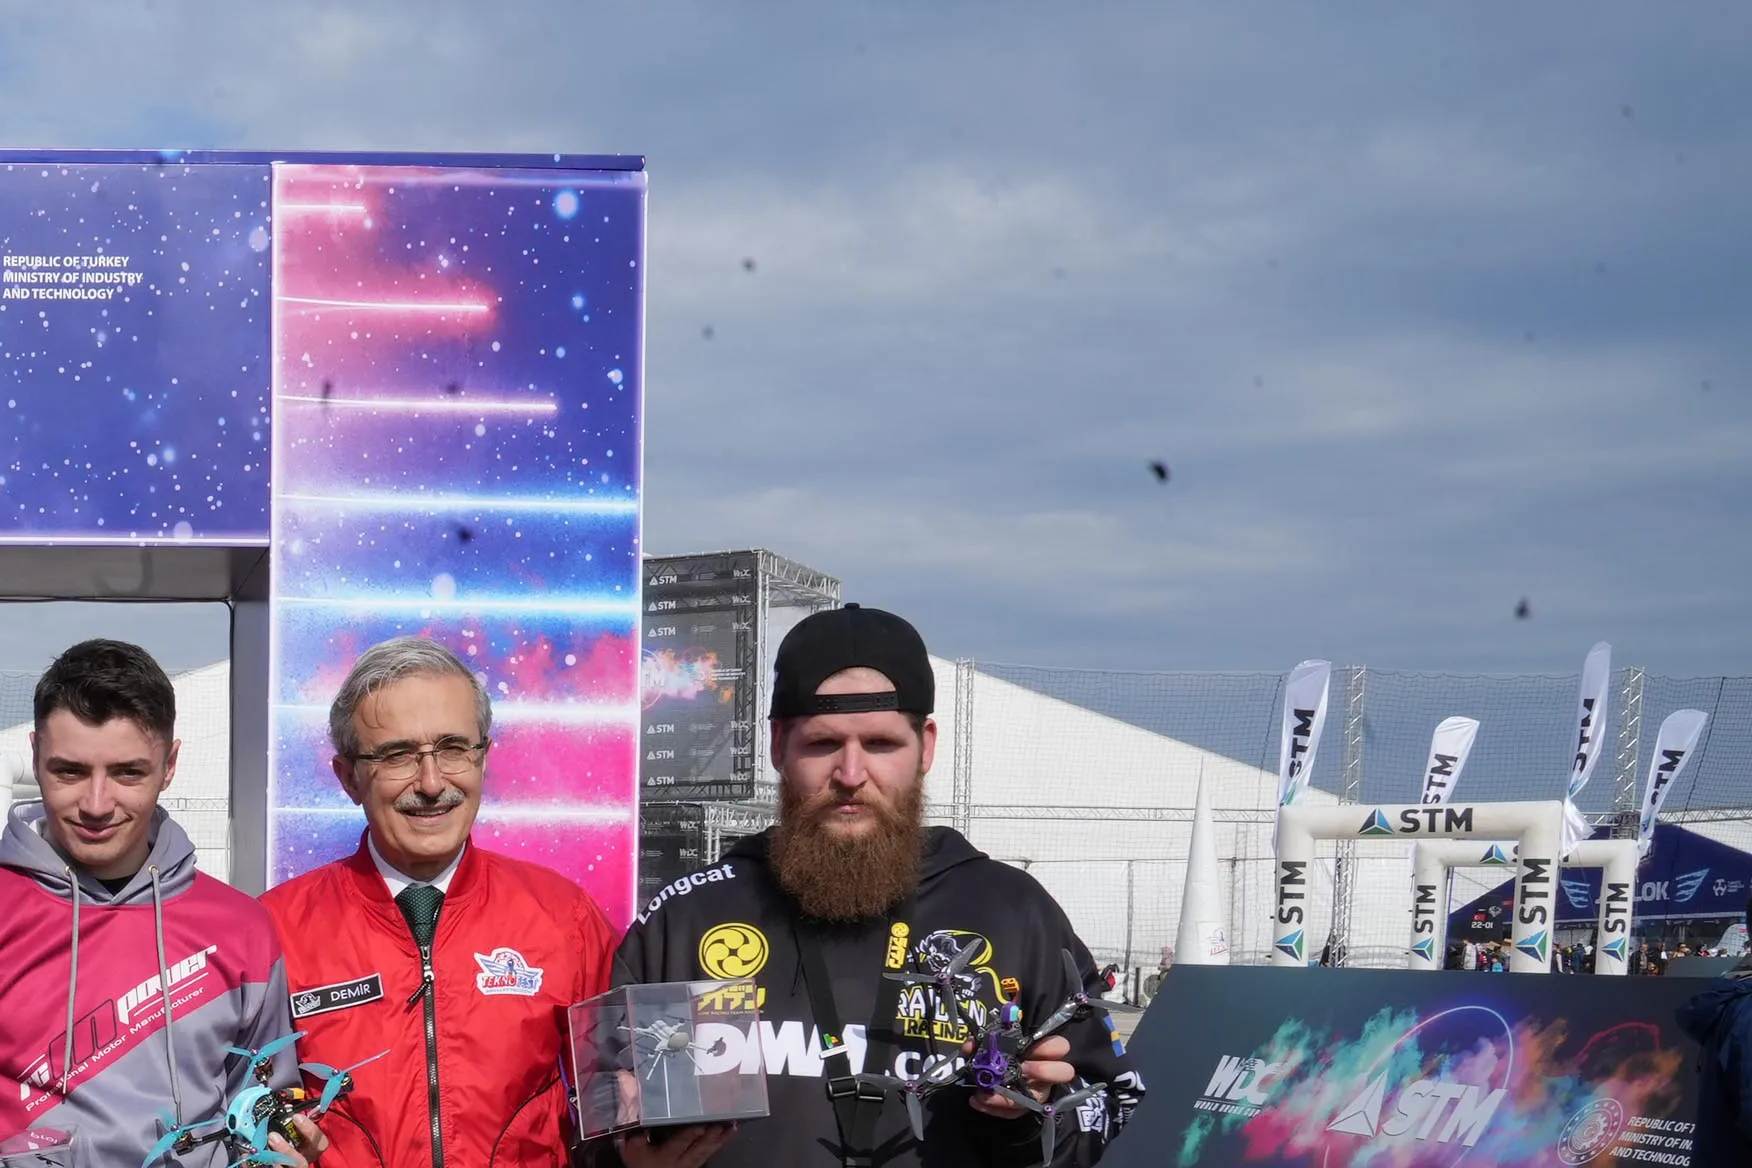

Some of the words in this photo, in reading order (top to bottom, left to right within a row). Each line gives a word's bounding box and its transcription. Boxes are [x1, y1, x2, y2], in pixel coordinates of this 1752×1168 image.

[3, 255, 61, 268] REPUBLIC
[63, 255, 81, 268] OF
[82, 255, 130, 268] TURKEY
[3, 271, 62, 284] MINISTRY
[63, 271, 80, 284] OF
[82, 271, 144, 284] INDUSTRY
[3, 288, 30, 300] AND
[31, 288, 115, 300] TECHNOLOGY
[656, 724, 675, 734] STM
[656, 750, 675, 760] STM
[1288, 708, 1315, 779] STM
[656, 776, 675, 786] STM
[1422, 753, 1458, 804] STM
[1399, 807, 1474, 833] STM
[637, 863, 736, 926] Longcat
[1278, 861, 1307, 925] STM
[1519, 858, 1551, 925] STM
[1414, 885, 1437, 934] STM
[1604, 883, 1630, 933] STM
[331, 983, 371, 1002] DEMİR
[92, 1034, 128, 1063] Motor
[1204, 1055, 1289, 1105] WDC
[1382, 1079, 1508, 1149] STM
[1627, 1116, 1676, 1132] REPUBLIC
[1674, 1121, 1690, 1134] OF
[1618, 1131, 1667, 1146] MINISTRY
[1664, 1137, 1681, 1148] OF
[1609, 1146, 1633, 1158] AND
[1632, 1149, 1691, 1167] TECHNOLOG
